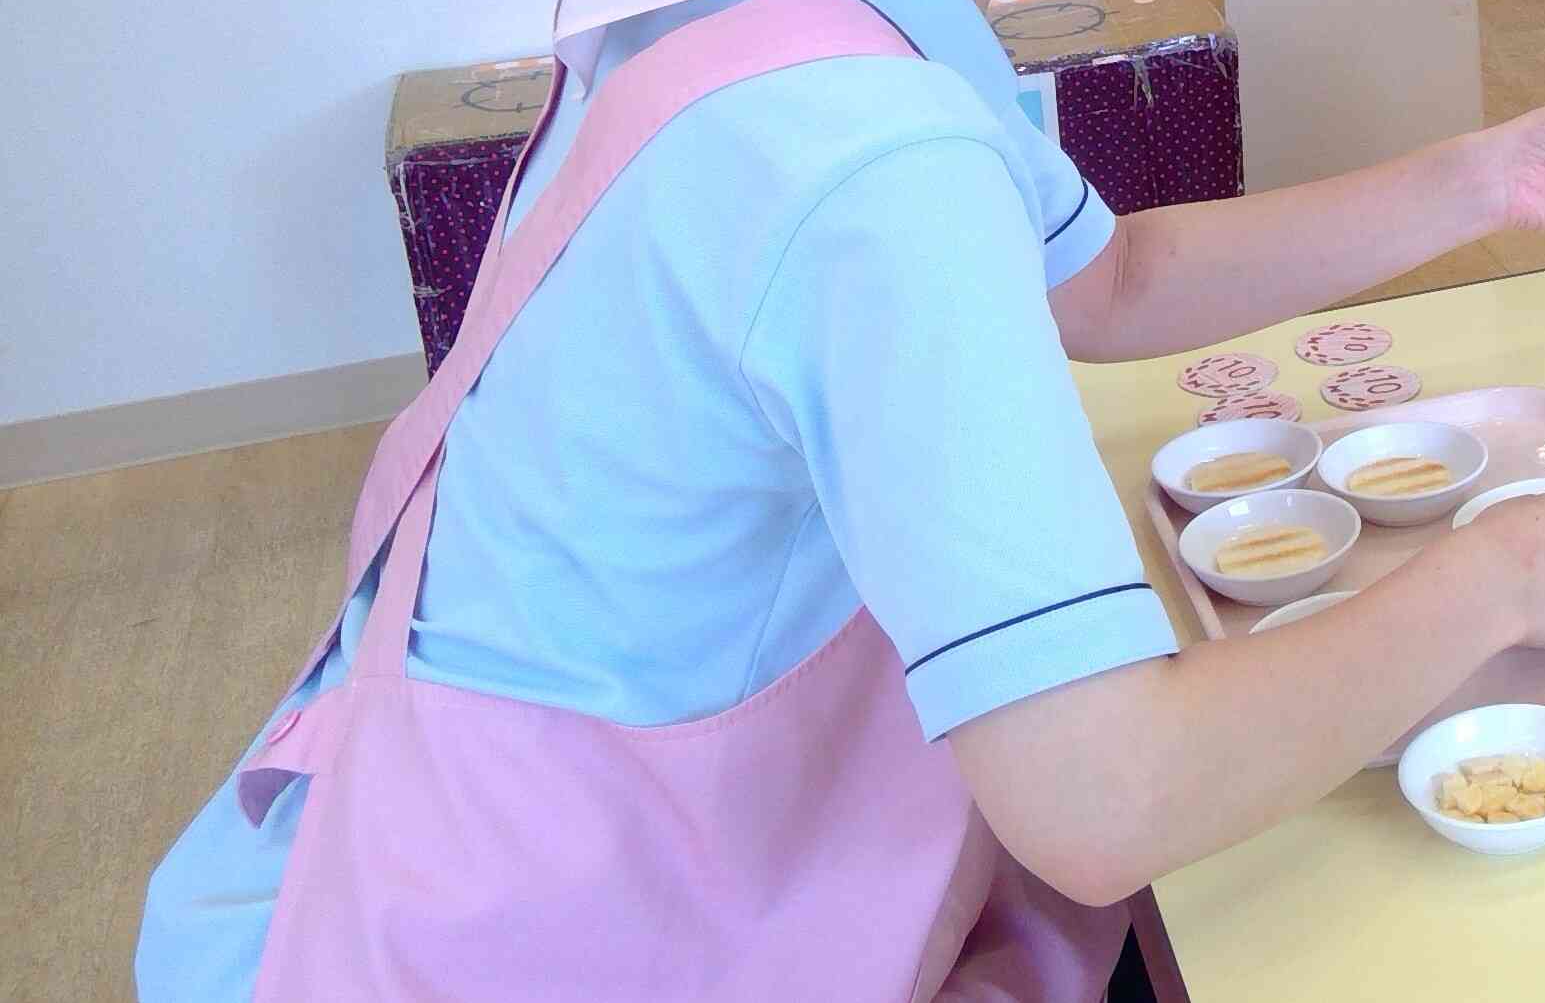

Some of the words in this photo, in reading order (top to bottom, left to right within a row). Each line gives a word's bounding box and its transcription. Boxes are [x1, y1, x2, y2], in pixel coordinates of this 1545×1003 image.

[1343, 335, 1375, 352] 10
[1218, 358, 1257, 379] 10
[1364, 373, 1403, 395] 10
